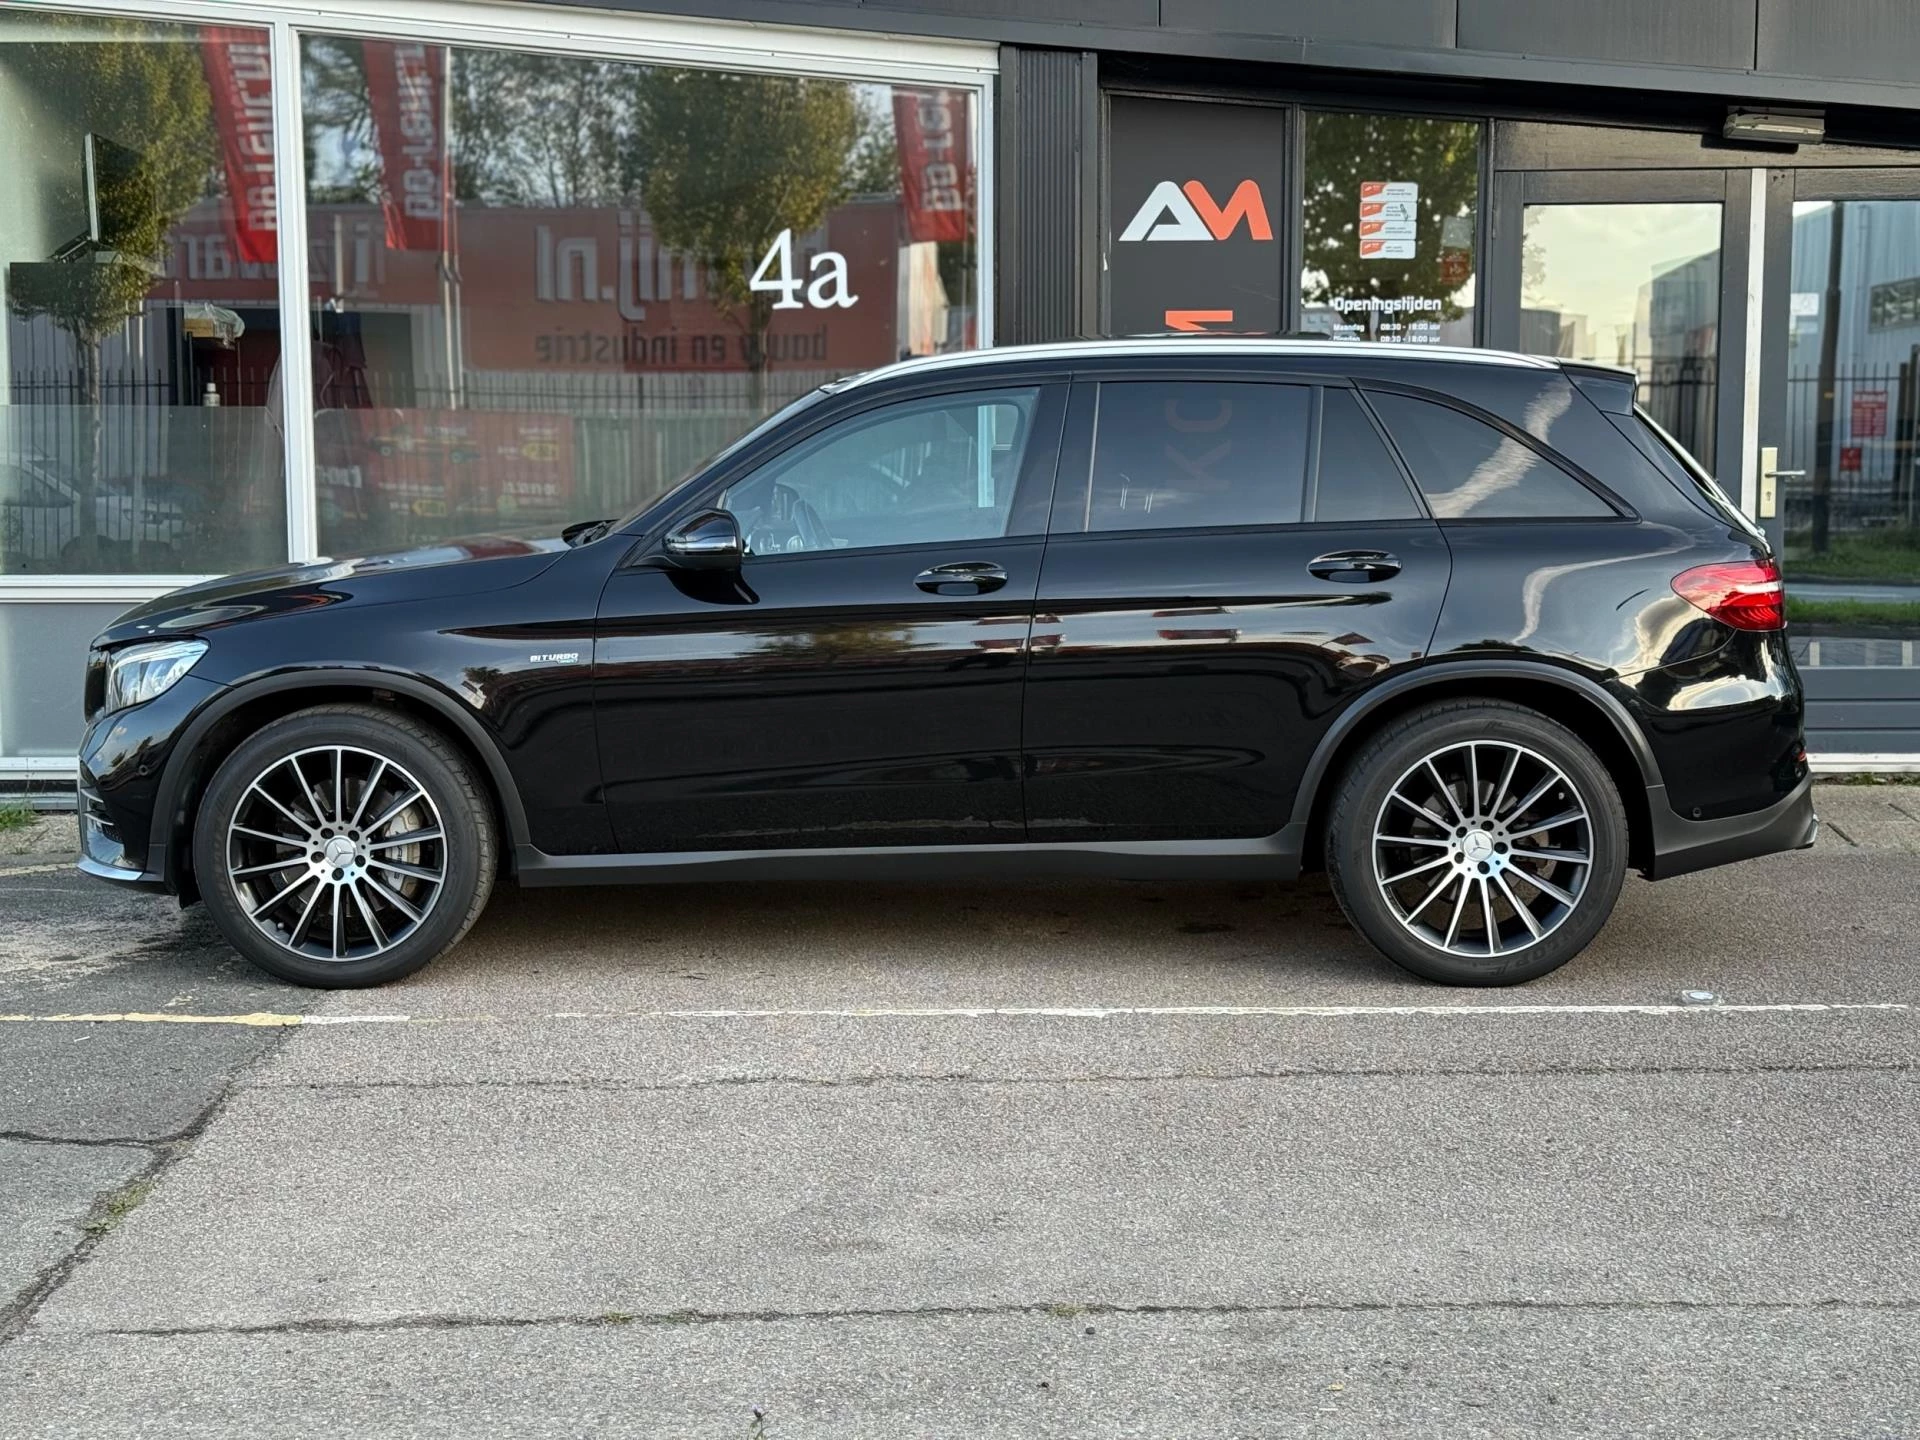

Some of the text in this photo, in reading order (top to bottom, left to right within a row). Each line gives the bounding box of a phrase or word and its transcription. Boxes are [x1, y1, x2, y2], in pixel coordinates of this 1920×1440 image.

[1118, 179, 1274, 242] AM
[749, 228, 859, 311] 4a
[1334, 296, 1442, 314] Openingstijden
[1333, 323, 1365, 333] Maandag
[530, 652, 578, 662] BITURBO
